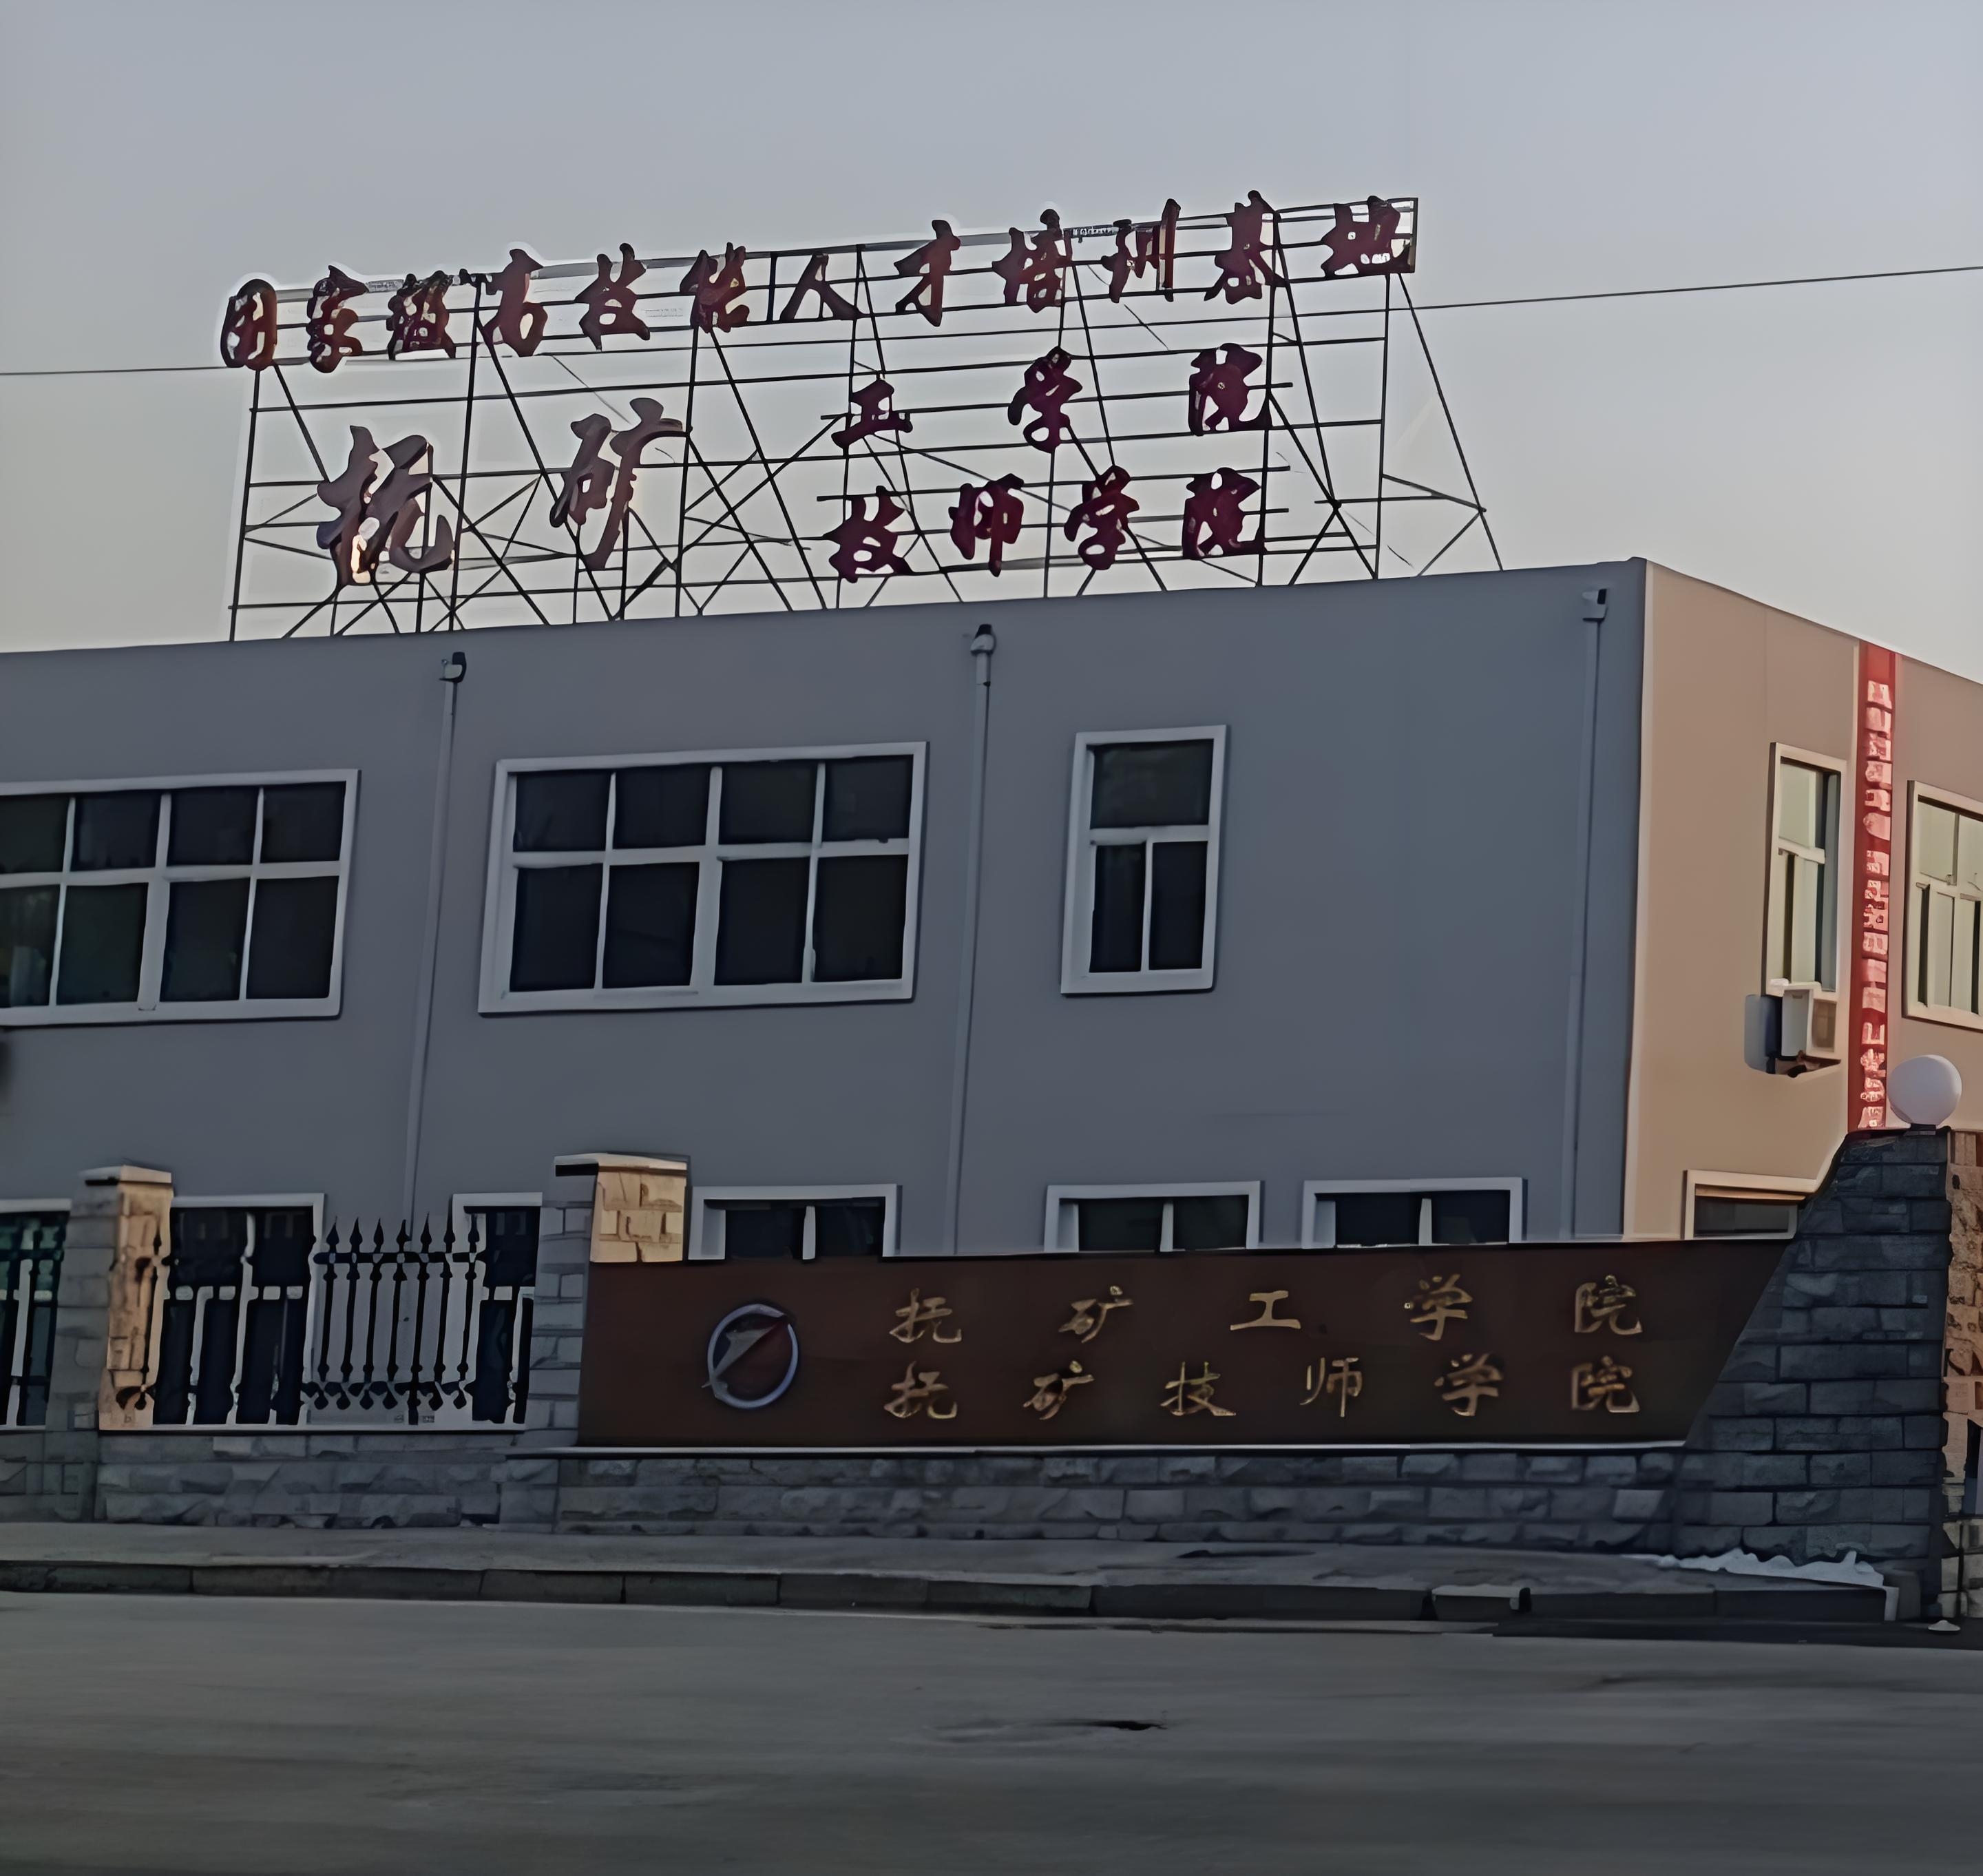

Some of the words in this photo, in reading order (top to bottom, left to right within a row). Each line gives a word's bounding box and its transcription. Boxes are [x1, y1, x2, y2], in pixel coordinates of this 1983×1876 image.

[317, 398, 687, 585] 抚矿
[825, 465, 1263, 583] 技师学院
[889, 1274, 1643, 1343] 抚矿工学院
[884, 1353, 1640, 1419] 抚矿技师学院
